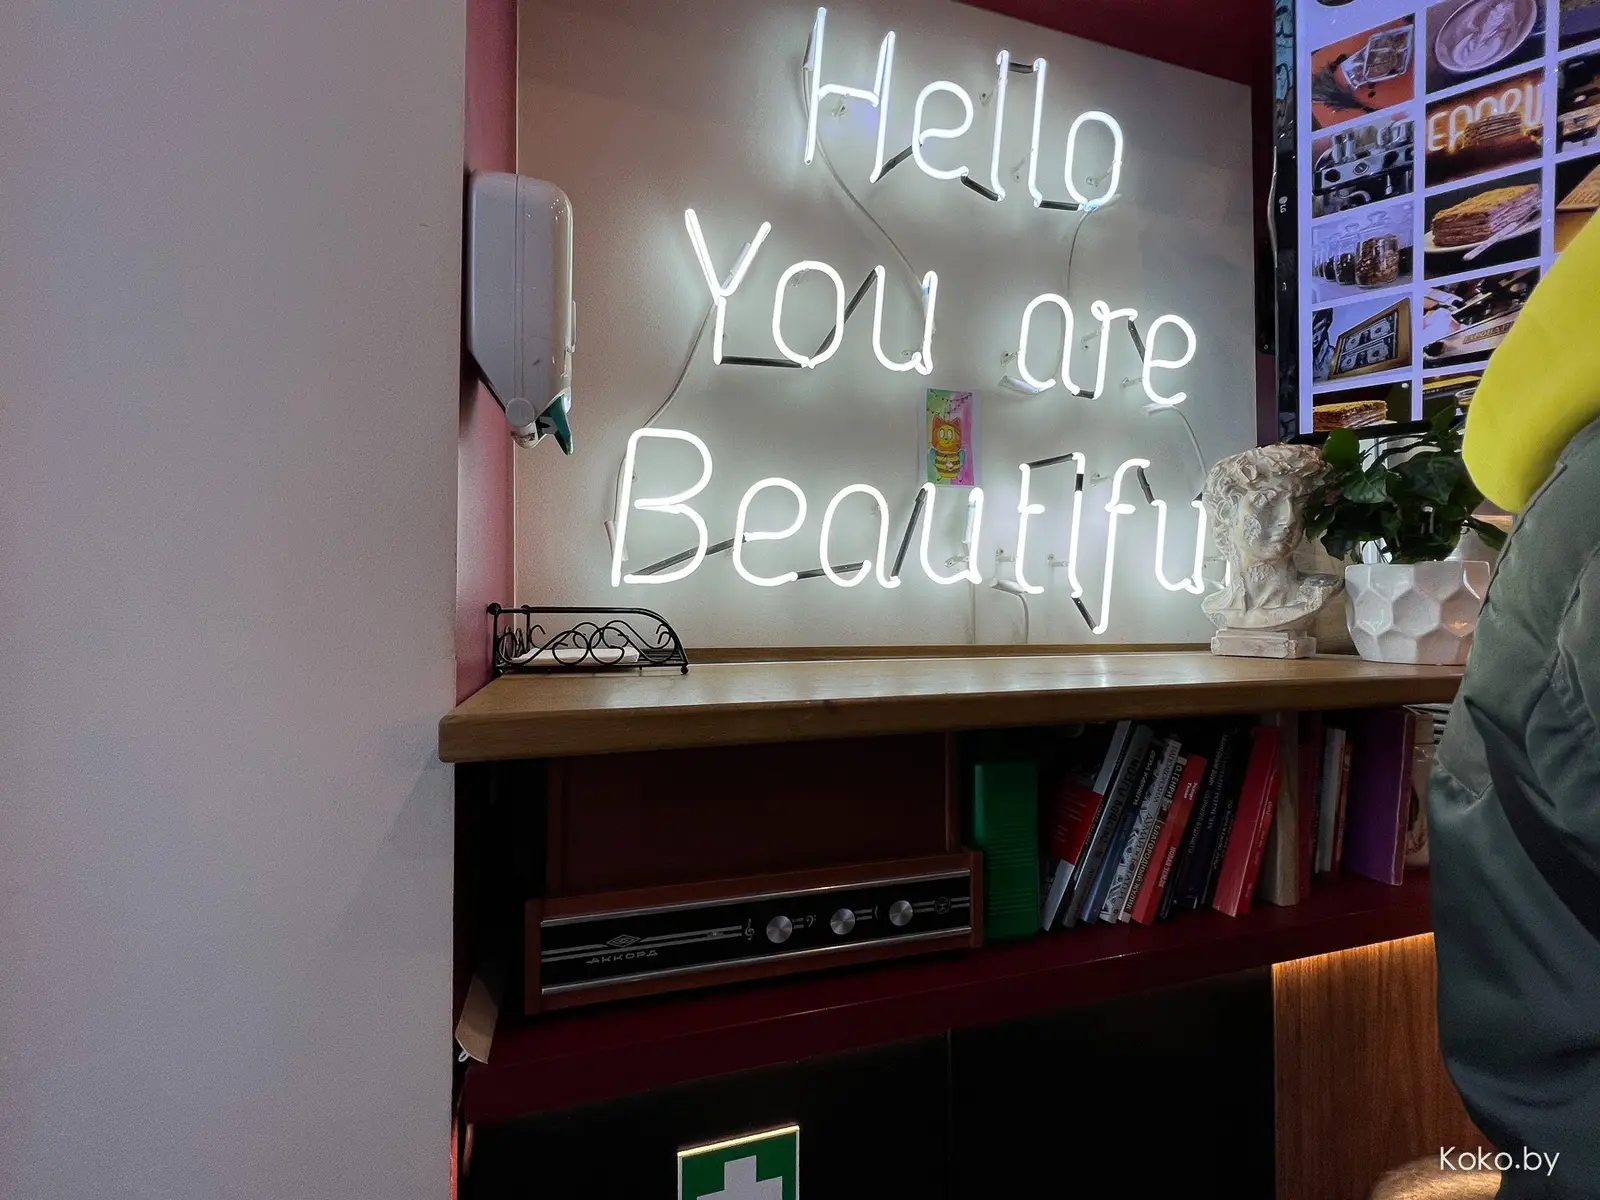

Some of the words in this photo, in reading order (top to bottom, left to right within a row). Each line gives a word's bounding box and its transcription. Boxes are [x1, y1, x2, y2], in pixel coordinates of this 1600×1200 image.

[804, 7, 1124, 209] Hello
[685, 208, 938, 375] You
[1018, 293, 1198, 405] are
[611, 428, 1230, 635] Beautifu
[1124, 882, 1139, 910] ЖУЛИК
[1134, 823, 1161, 883] БЛАГОРОДНЫЙ
[586, 949, 659, 965] АККОРД
